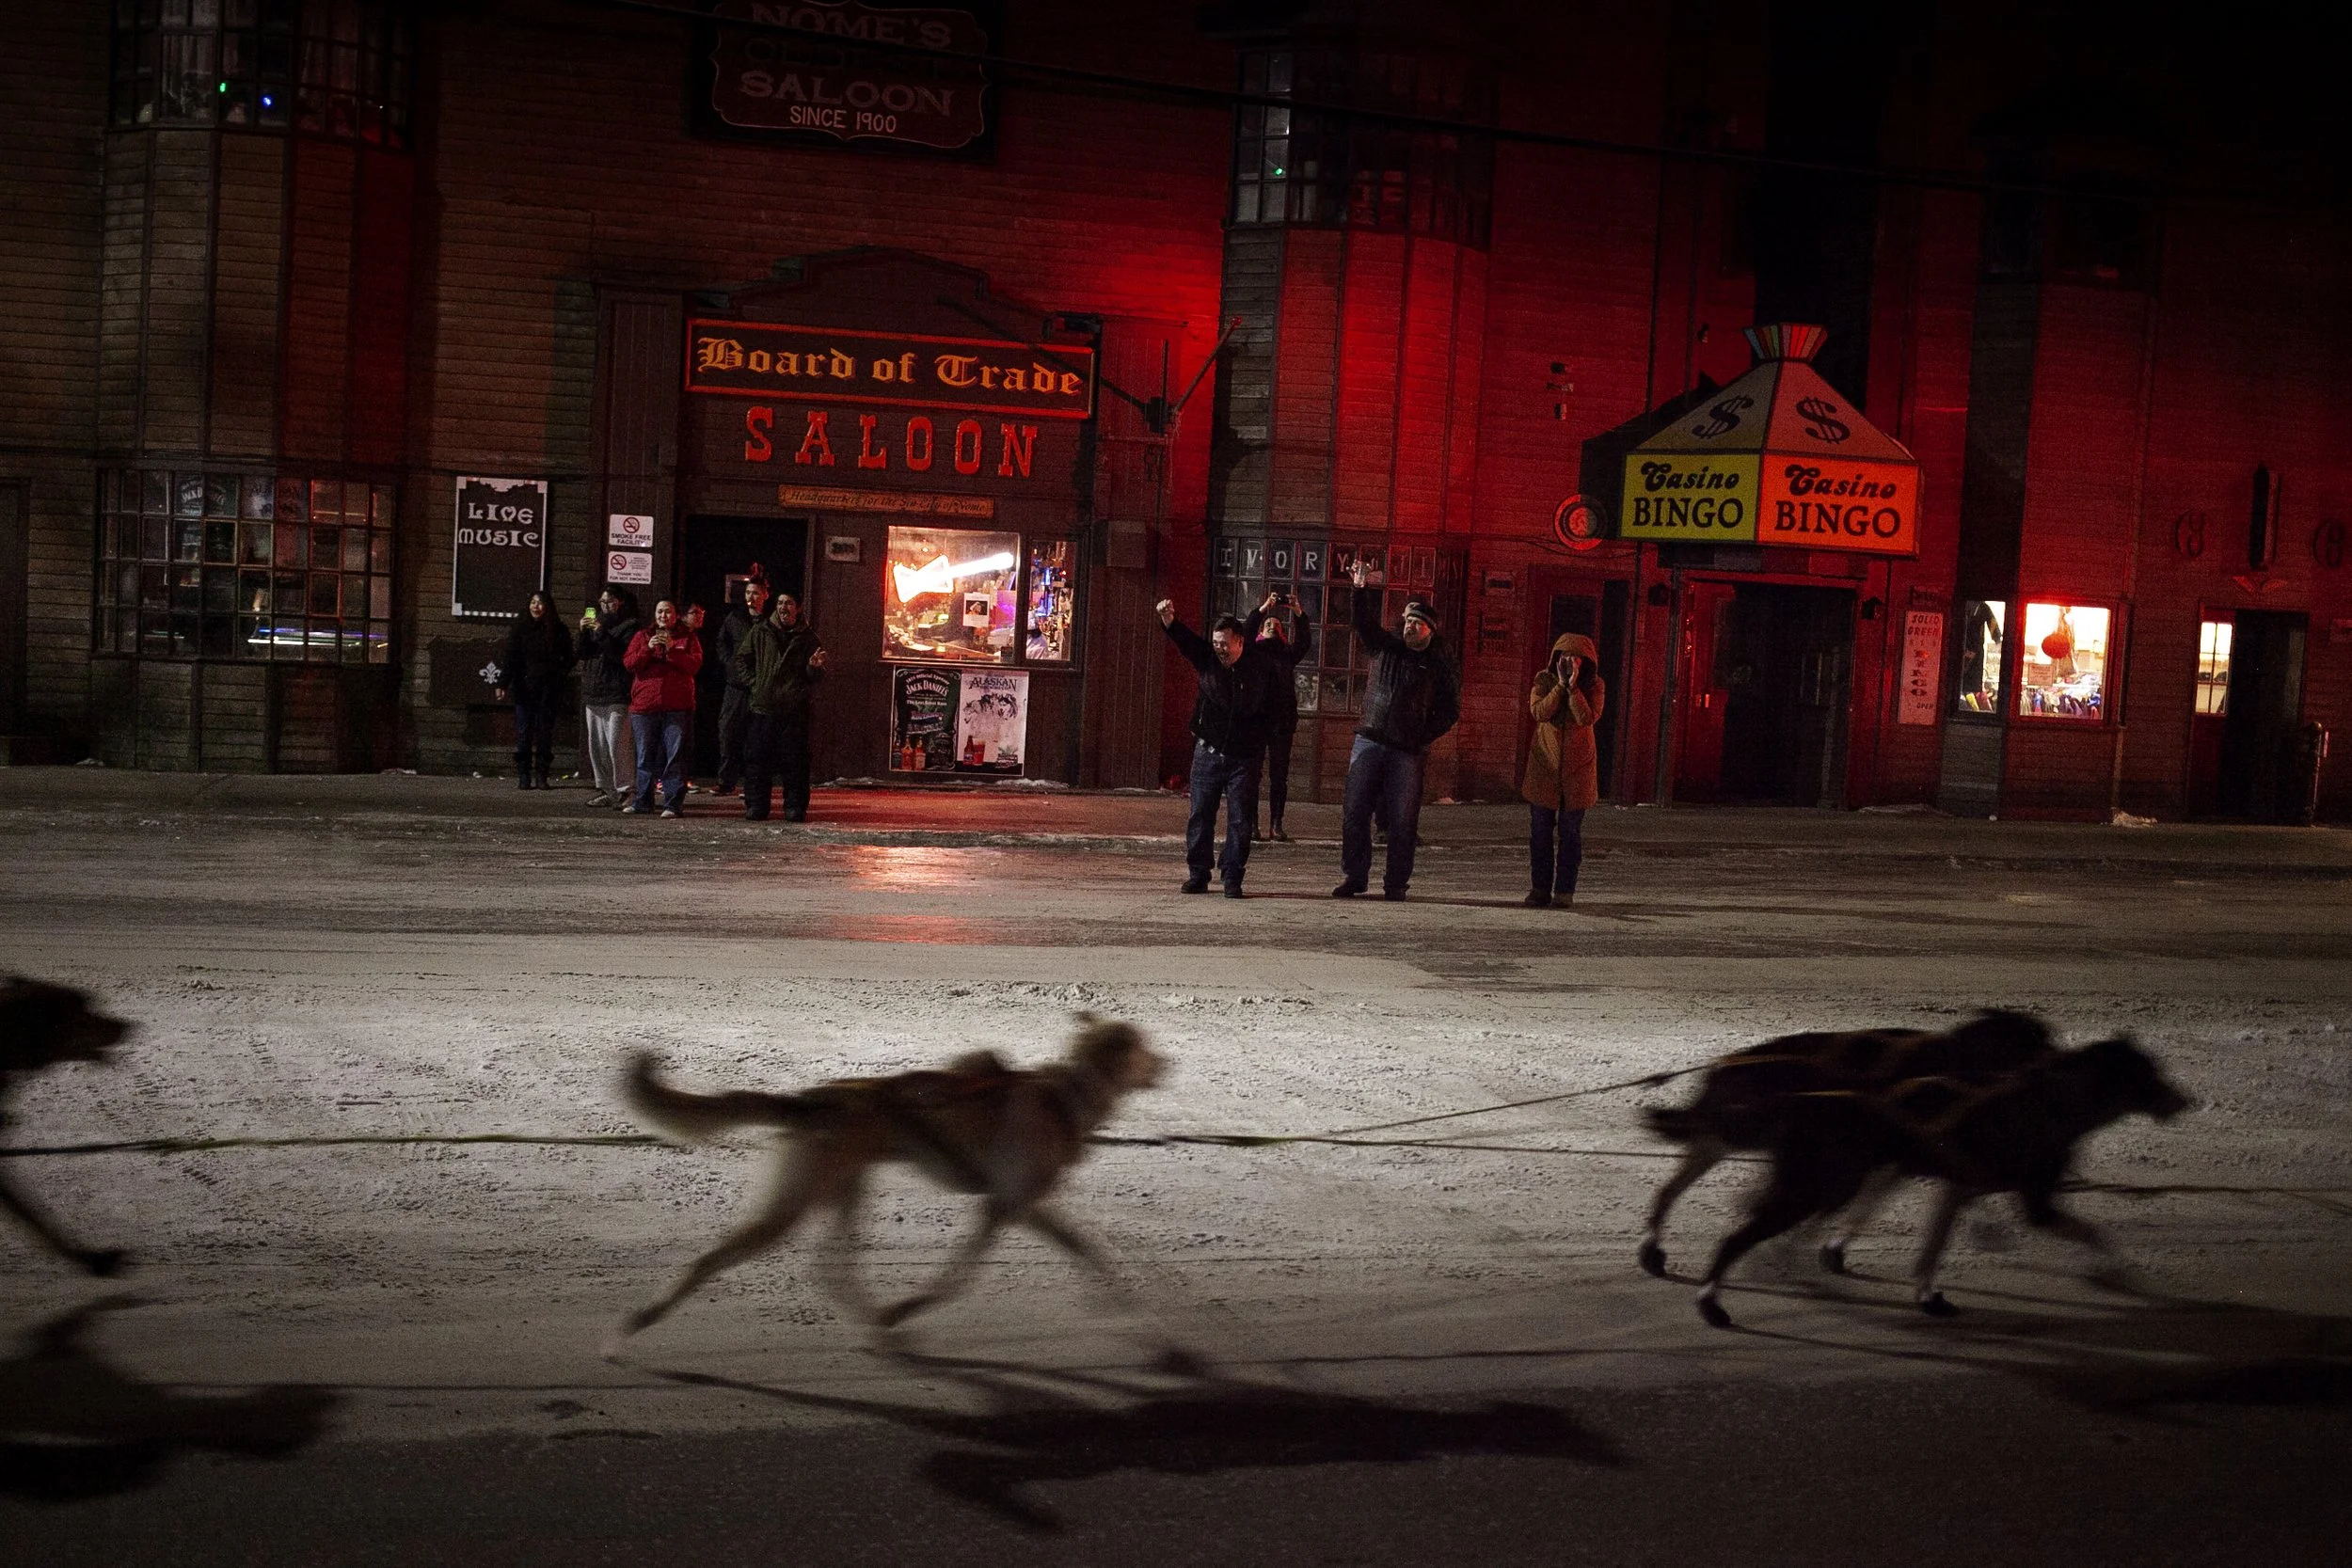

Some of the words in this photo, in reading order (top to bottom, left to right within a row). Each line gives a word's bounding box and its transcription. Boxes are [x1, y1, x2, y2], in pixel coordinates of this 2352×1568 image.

[751, 2, 953, 48] NOME'S
[739, 70, 955, 117] SALOON
[789, 105, 847, 130] SINCE
[855, 111, 897, 134] 1900
[696, 335, 855, 380] Board
[871, 352, 919, 383] of
[934, 354, 1084, 396] Trade
[743, 405, 1039, 478] SALOON
[1641, 462, 1740, 492] Casino
[1786, 464, 1898, 499] Casino
[1632, 497, 1743, 528] BINGO
[1775, 500, 1900, 538] BINGO
[1220, 547, 1349, 574] IVORY
[969, 676, 1017, 691] ALASKAN
